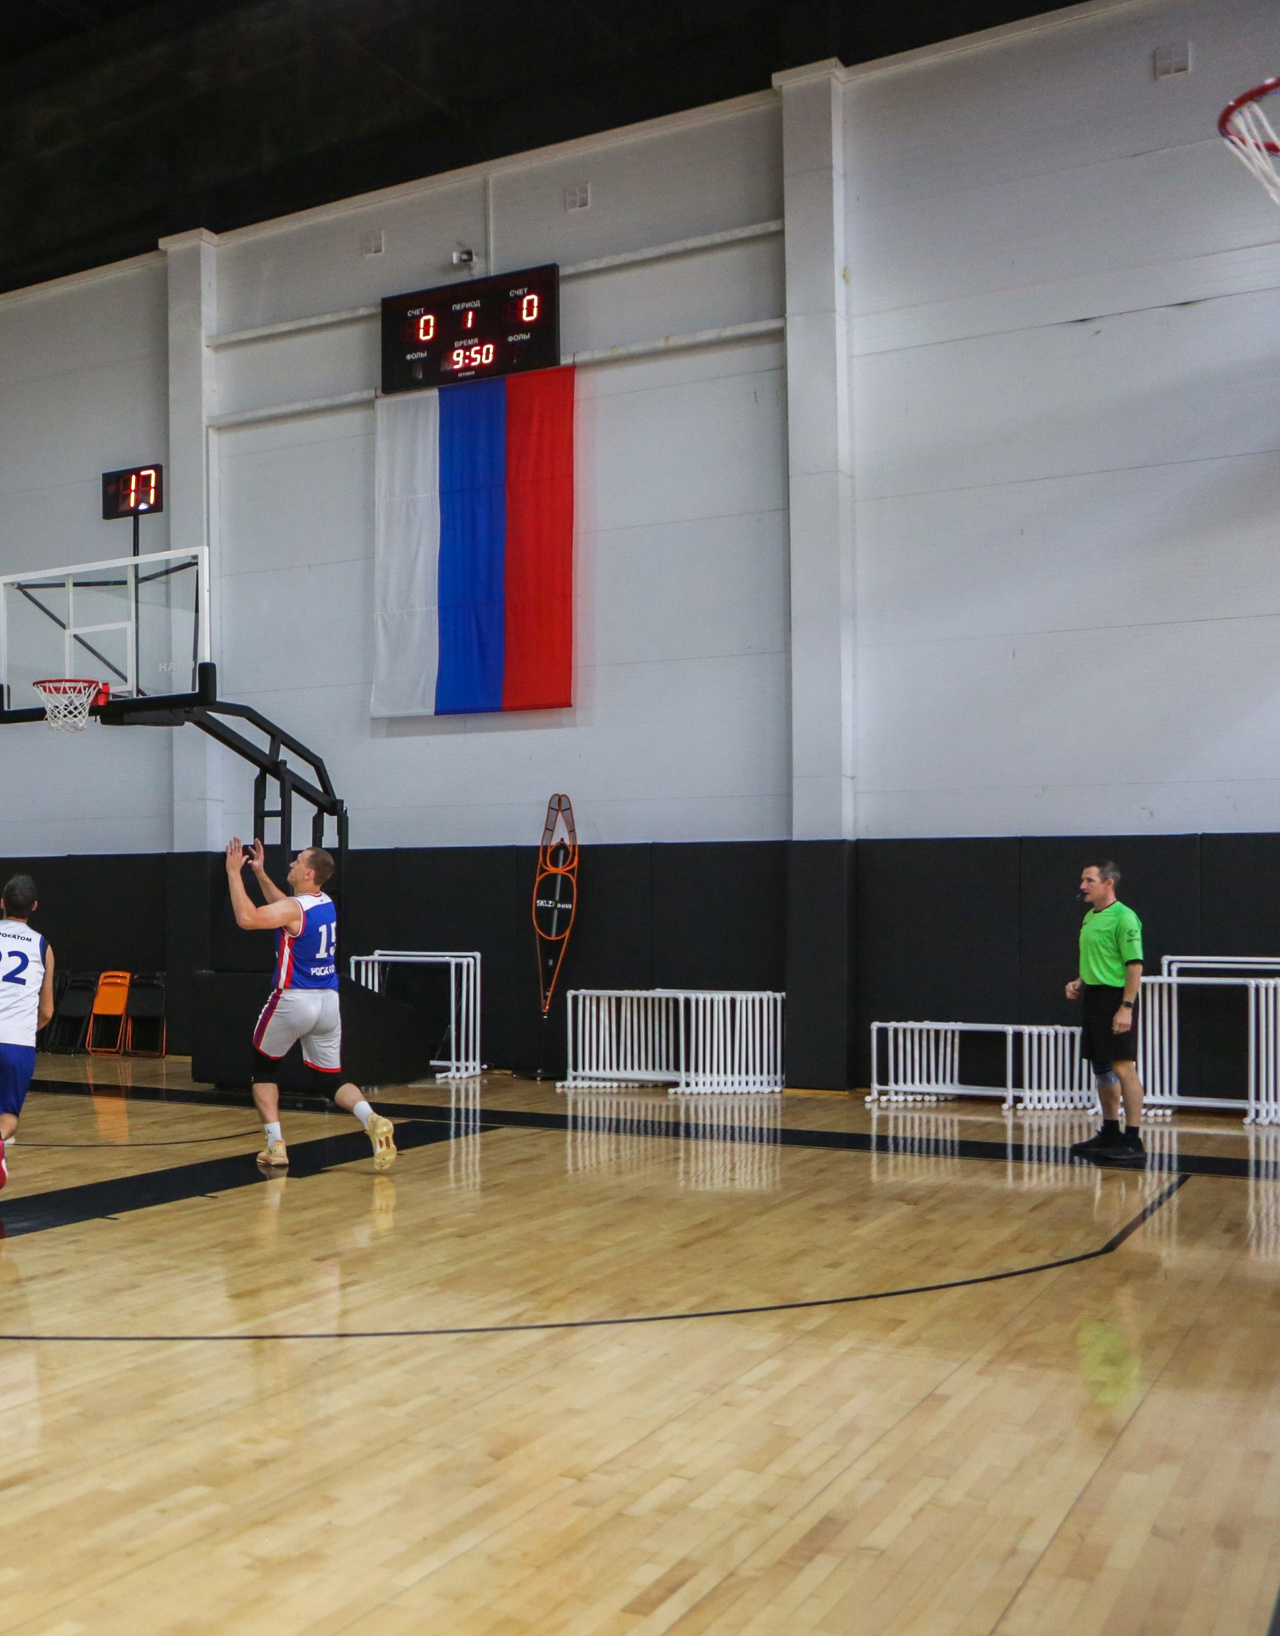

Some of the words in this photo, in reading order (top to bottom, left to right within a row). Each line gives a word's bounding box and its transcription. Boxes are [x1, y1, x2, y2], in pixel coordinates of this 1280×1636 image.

[509, 287, 528, 297] СЧЕТ
[452, 300, 481, 312] ПЕРИОД
[522, 294, 538, 322] 0
[407, 308, 425, 317] СЧЕТ
[466, 310, 473, 328] 1
[419, 314, 435, 341] 0
[454, 338, 479, 348] ВРЕМЯ
[507, 333, 531, 343] ФОЛЫ
[405, 351, 427, 361] ФОЛЫ
[452, 343, 494, 369] 9:50
[129, 469, 156, 508] 17
